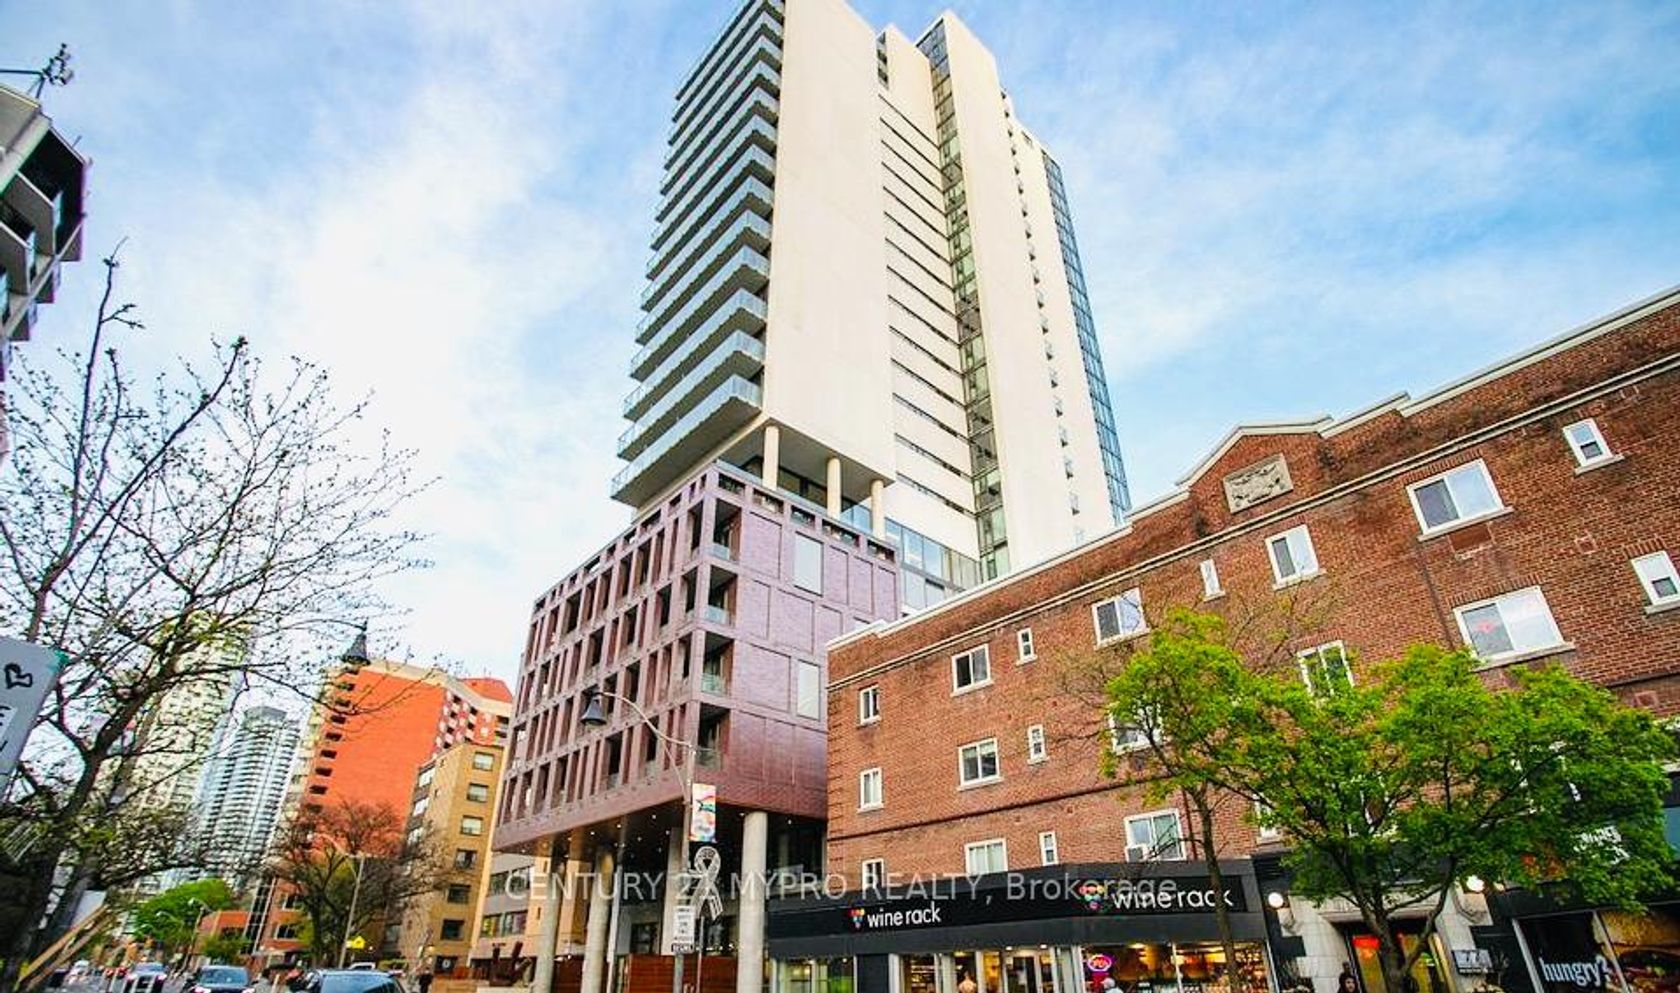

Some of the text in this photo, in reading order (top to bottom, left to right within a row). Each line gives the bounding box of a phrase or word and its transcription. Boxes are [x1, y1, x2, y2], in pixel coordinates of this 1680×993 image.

[1111, 886, 1172, 909] wine
[867, 900, 942, 928] wine rack
[1539, 954, 1613, 987] hungry?
